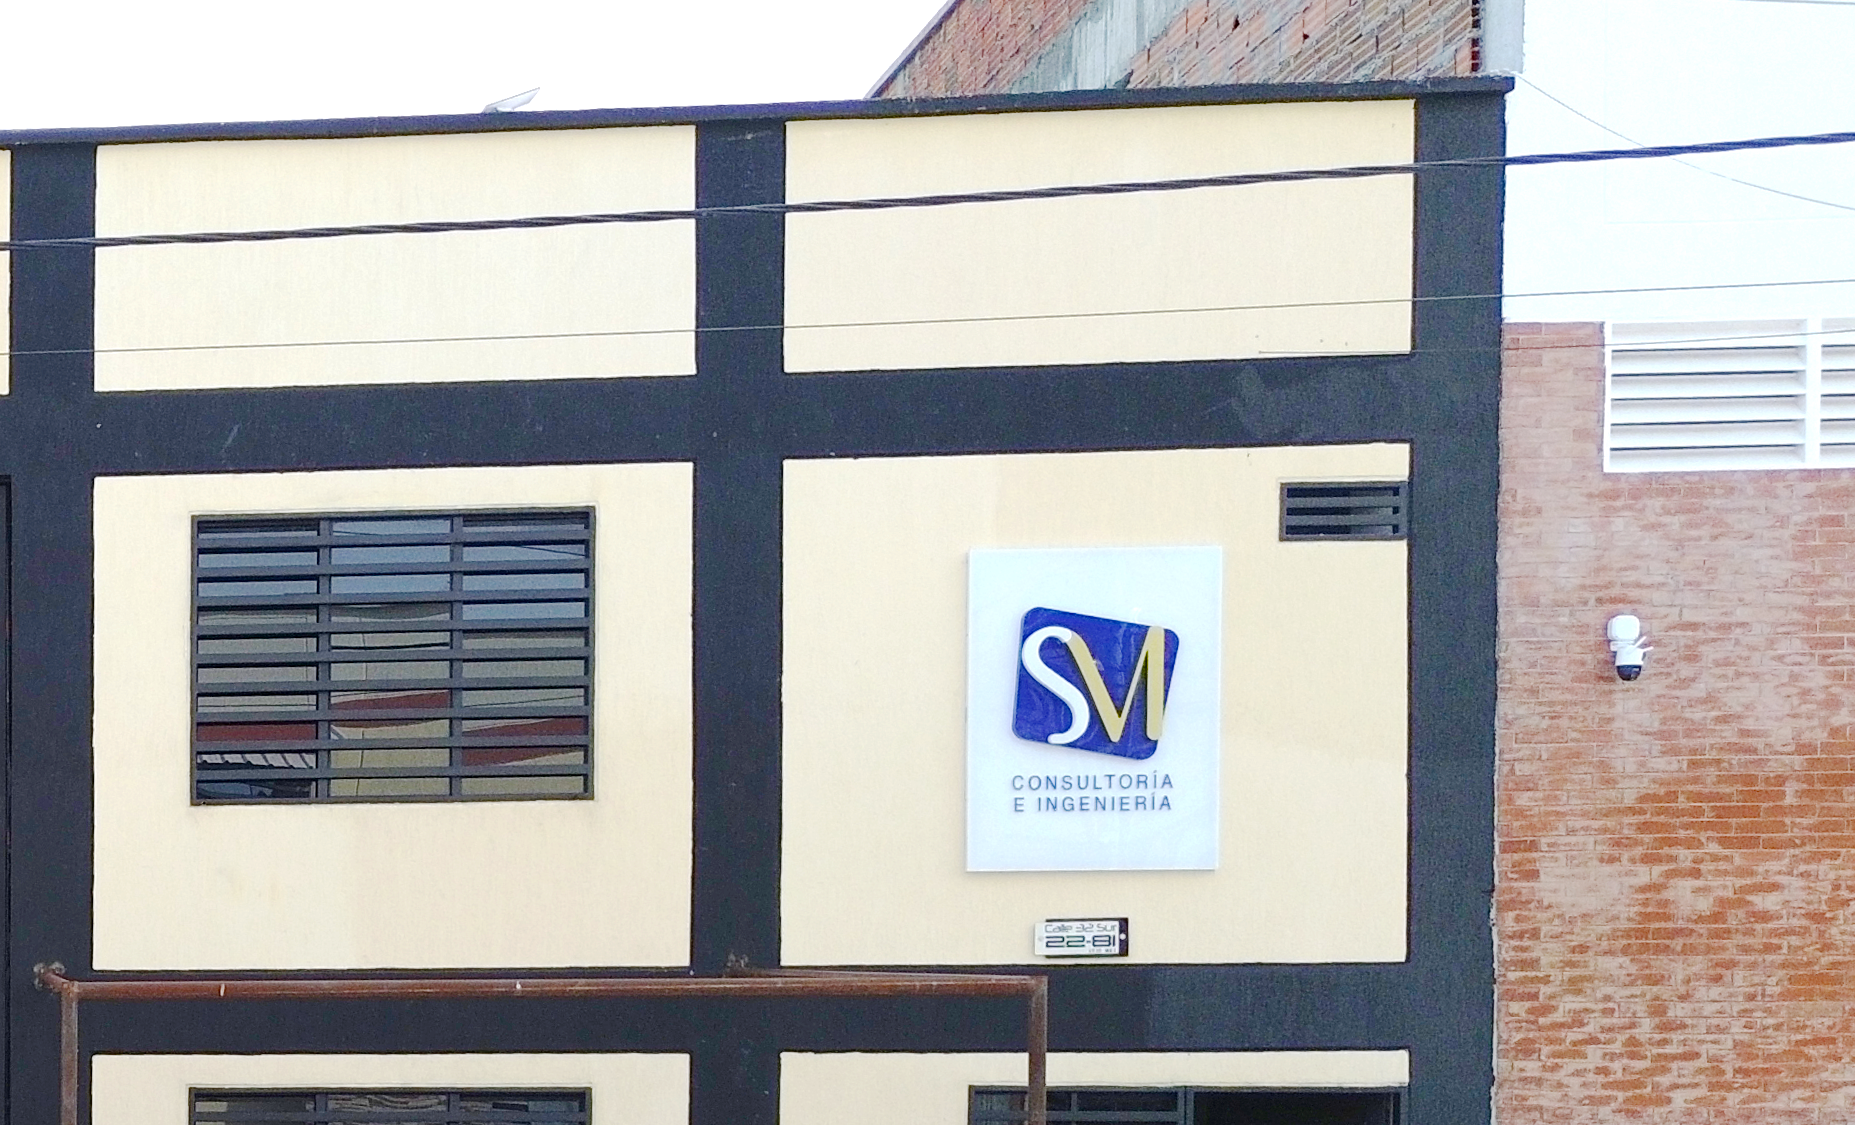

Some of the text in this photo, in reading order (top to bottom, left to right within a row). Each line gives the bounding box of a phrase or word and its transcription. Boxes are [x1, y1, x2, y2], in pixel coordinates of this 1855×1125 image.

[1011, 769, 1174, 791] CONSULTORÍA
[1013, 791, 1172, 812] E INGENIERÍA
[1096, 922, 1117, 932] Sur
[1045, 934, 1116, 948] 22-81
